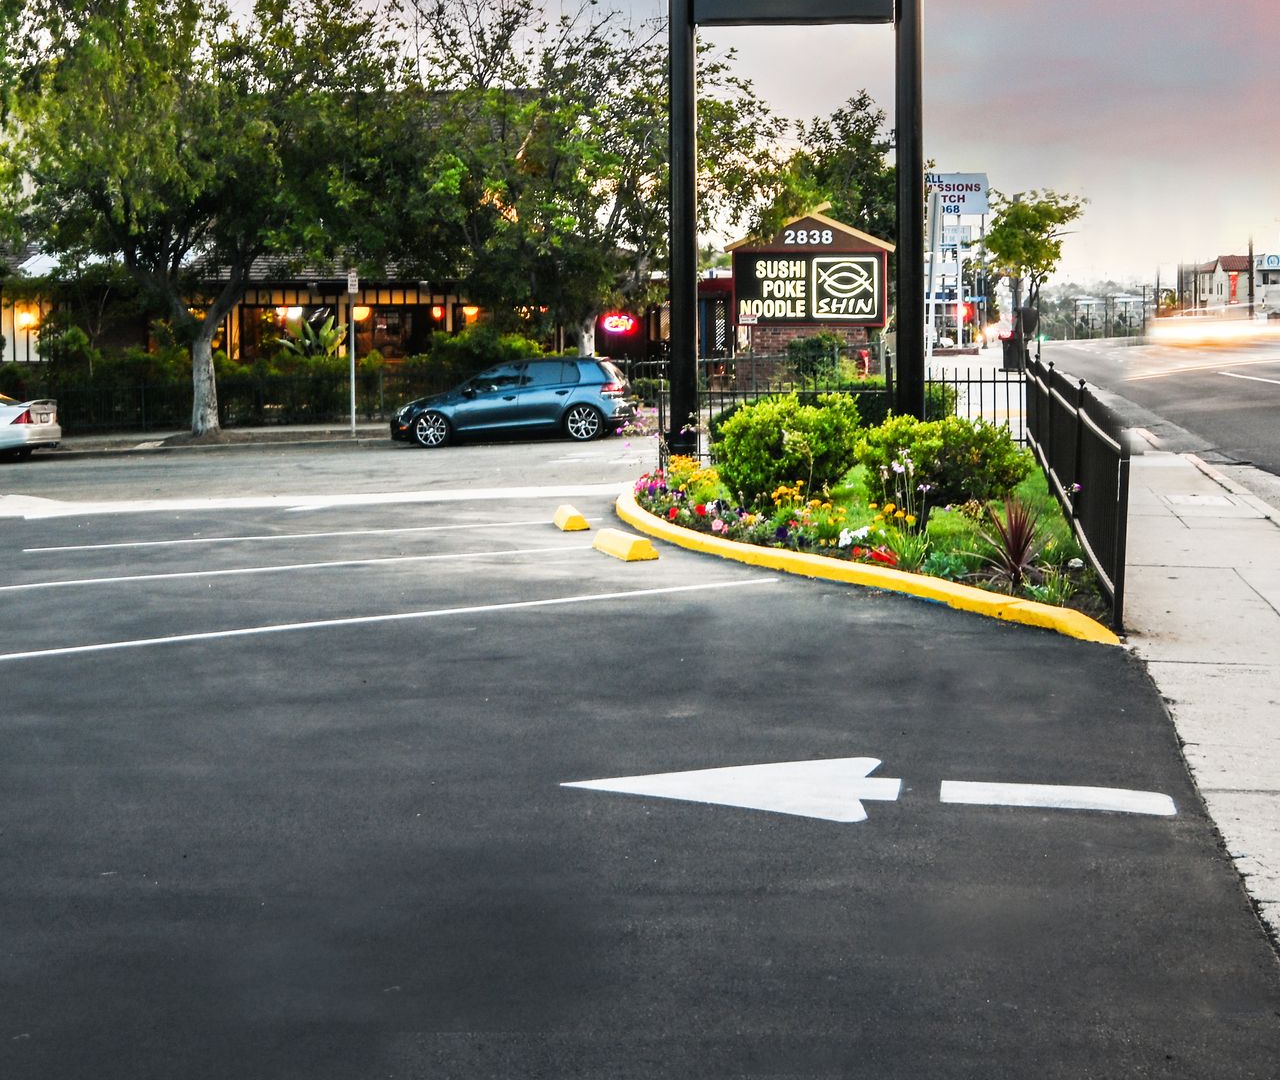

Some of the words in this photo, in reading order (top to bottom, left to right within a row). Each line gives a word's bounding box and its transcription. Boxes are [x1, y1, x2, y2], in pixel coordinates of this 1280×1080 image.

[784, 229, 833, 245] 2838
[755, 260, 806, 279] SUSHI
[762, 280, 806, 298] POKE
[739, 299, 806, 318] NOODLE
[818, 297, 873, 314] SHIN
